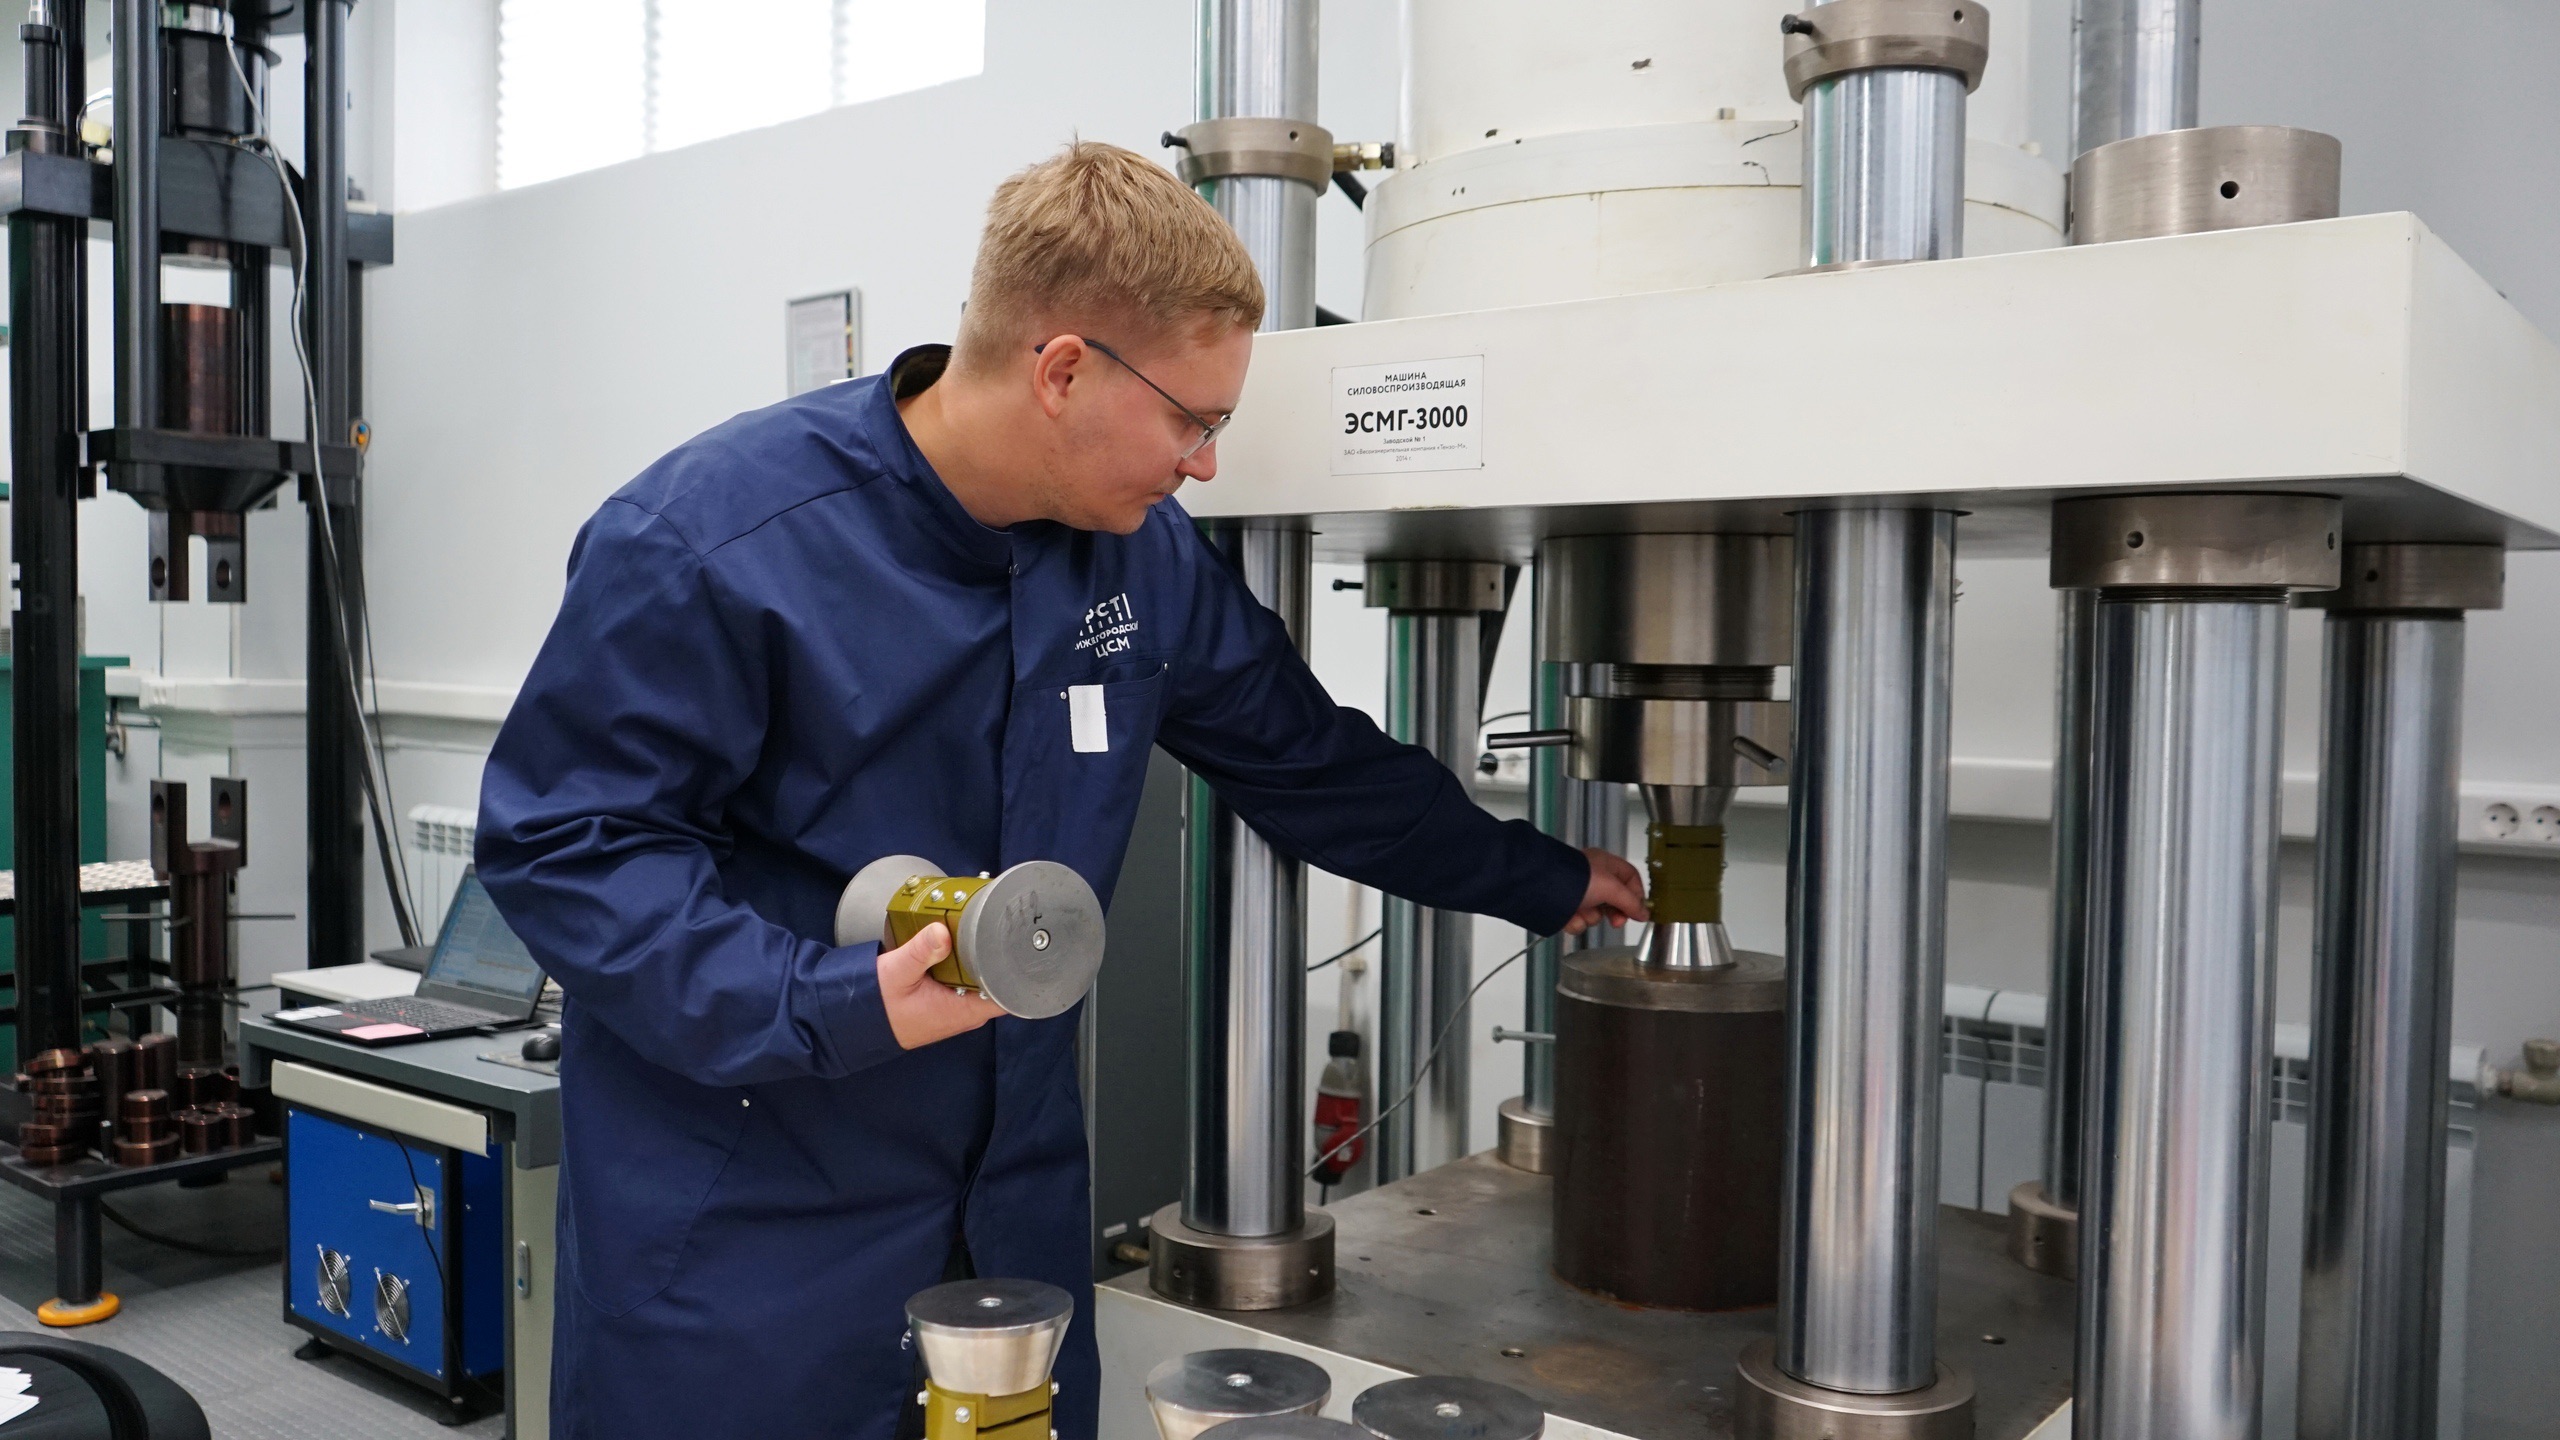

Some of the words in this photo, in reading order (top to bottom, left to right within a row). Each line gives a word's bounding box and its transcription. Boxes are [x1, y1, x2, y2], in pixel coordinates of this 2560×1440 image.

[1385, 372, 1427, 382] МАШИНА
[1347, 379, 1466, 396] СИЛОВОСПРОИЗВОДЯЩАЯ
[1344, 405, 1468, 434] ЭСМГ-3000
[1095, 636, 1131, 659] ЦСМ
